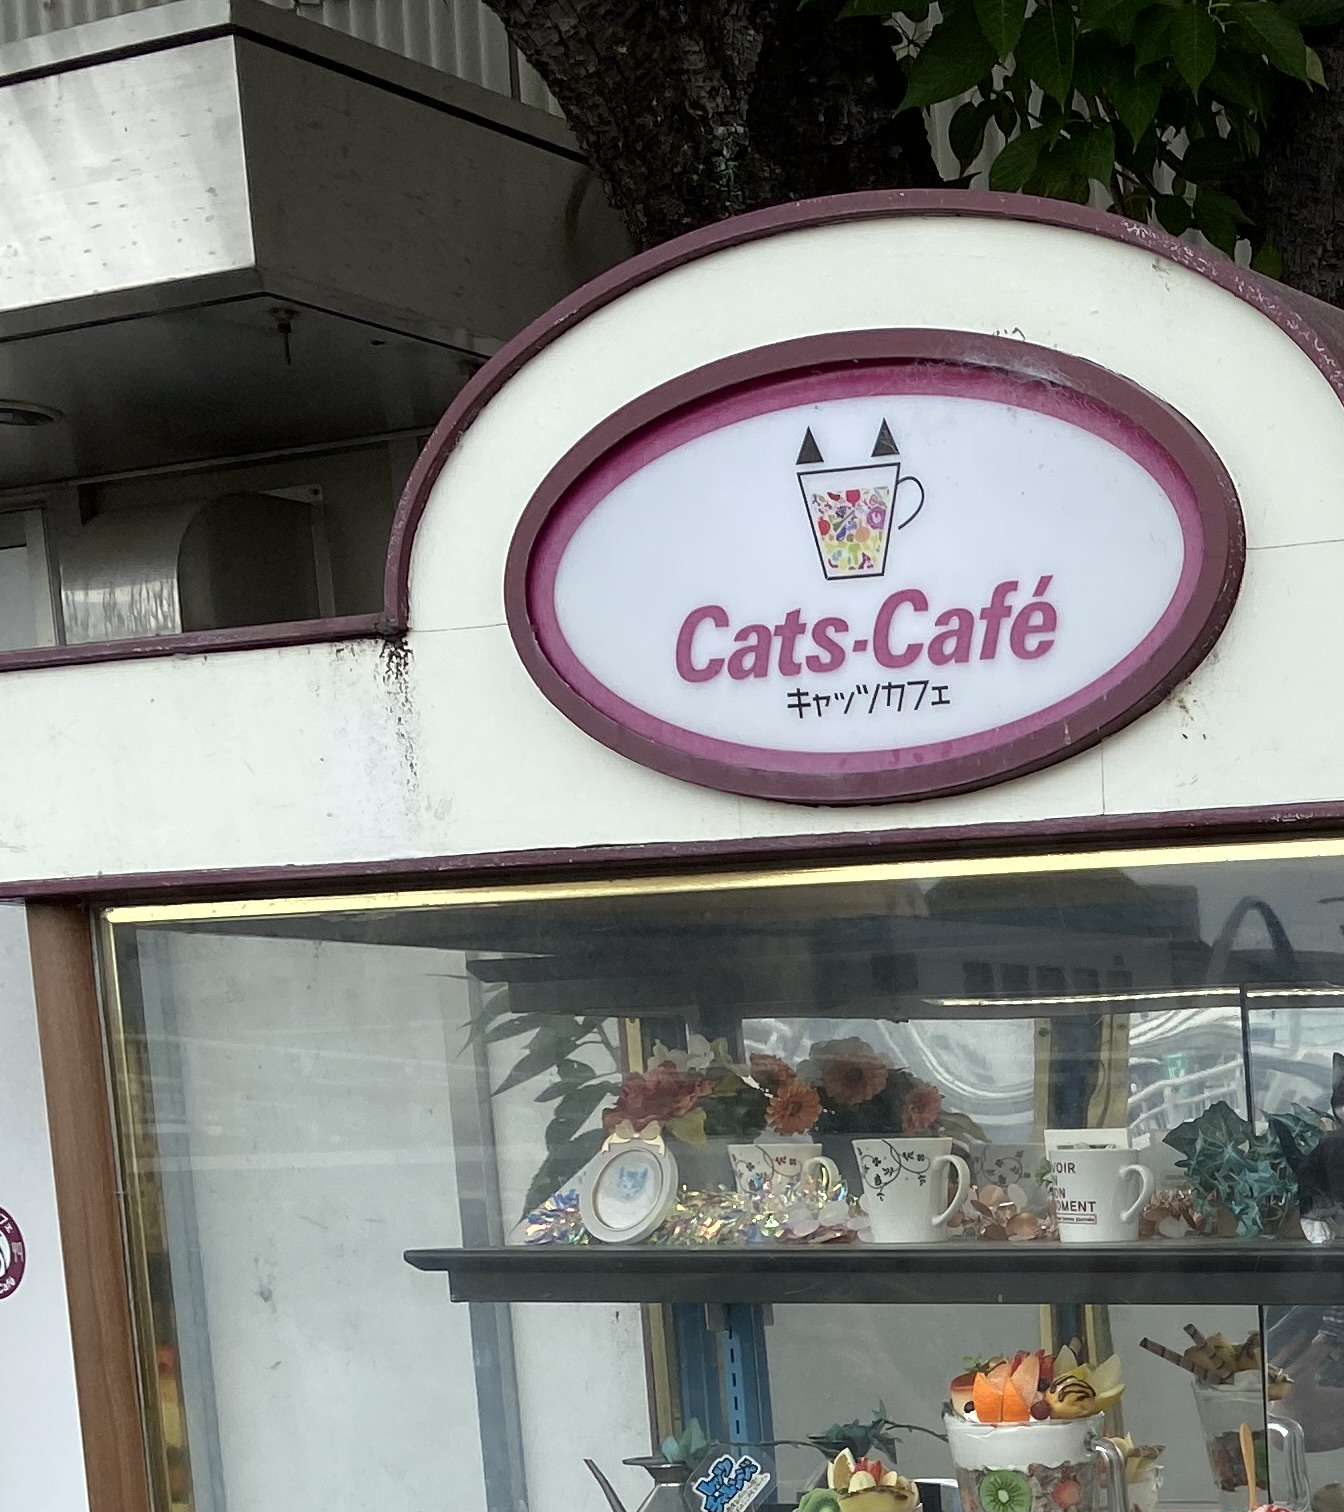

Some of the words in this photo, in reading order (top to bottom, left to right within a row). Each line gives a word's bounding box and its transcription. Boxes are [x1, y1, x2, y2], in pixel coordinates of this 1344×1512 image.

[674, 574, 1058, 683] Cats-Café
[786, 679, 951, 719] キャッツカフェ
